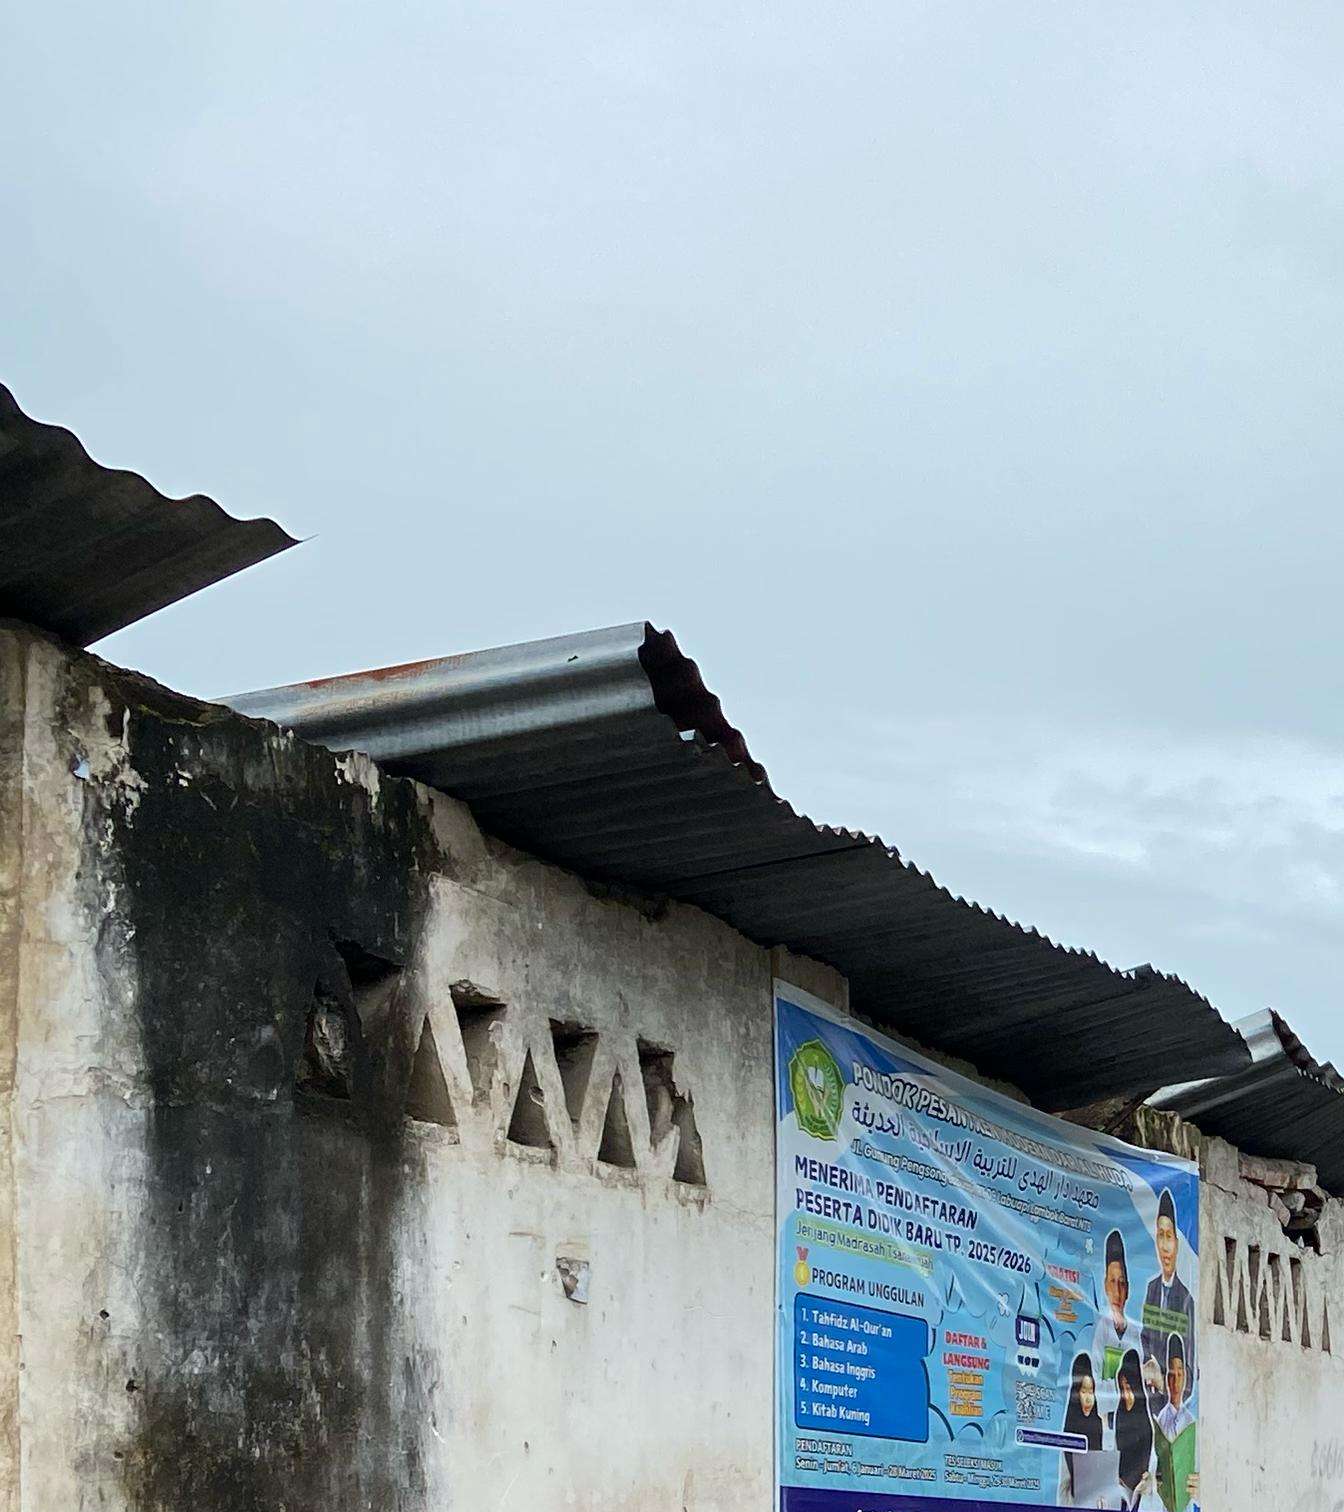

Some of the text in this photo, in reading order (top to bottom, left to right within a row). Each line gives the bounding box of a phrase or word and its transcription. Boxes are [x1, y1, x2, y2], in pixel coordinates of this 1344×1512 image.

[853, 1061, 919, 1109] PONDOK
[916, 1087, 1001, 1141] PESANTREN
[852, 1101, 904, 1137] الحديثة
[974, 1148, 1018, 1180] للتربية
[795, 1154, 874, 1198] MENERIMA
[876, 1180, 978, 1230] PENDAFTARAN
[1018, 1169, 1053, 1195] الهدى
[1054, 1175, 1070, 1200] دار
[1072, 1186, 1099, 1209] معهد
[795, 1188, 863, 1227] PESERTA
[868, 1208, 902, 1239] DIDIK
[906, 1221, 943, 1249] BARU
[968, 1240, 1032, 1274] 2025/2026
[796, 1220, 836, 1246] Jenjang
[837, 1233, 885, 1255] Madrasah
[812, 1268, 925, 1307] PROGRAM UNGGULAN
[802, 1308, 809, 1321] 1.
[812, 1310, 849, 1330] Tahfidz
[800, 1331, 868, 1355] 2. Bahasa Arab
[945, 1331, 980, 1349] DAFTAR
[800, 1355, 876, 1380] 3. Bahasa Inggris
[943, 1352, 990, 1371] LANGSUNG
[800, 1378, 858, 1399] 4. Komputer
[801, 1401, 870, 1426] 5. Kitab Kuning
[795, 1438, 853, 1456] PENDAFTARAN
[795, 1456, 818, 1470] Senin
[857, 1461, 884, 1477] Januari
[898, 1465, 922, 1480] Maret
